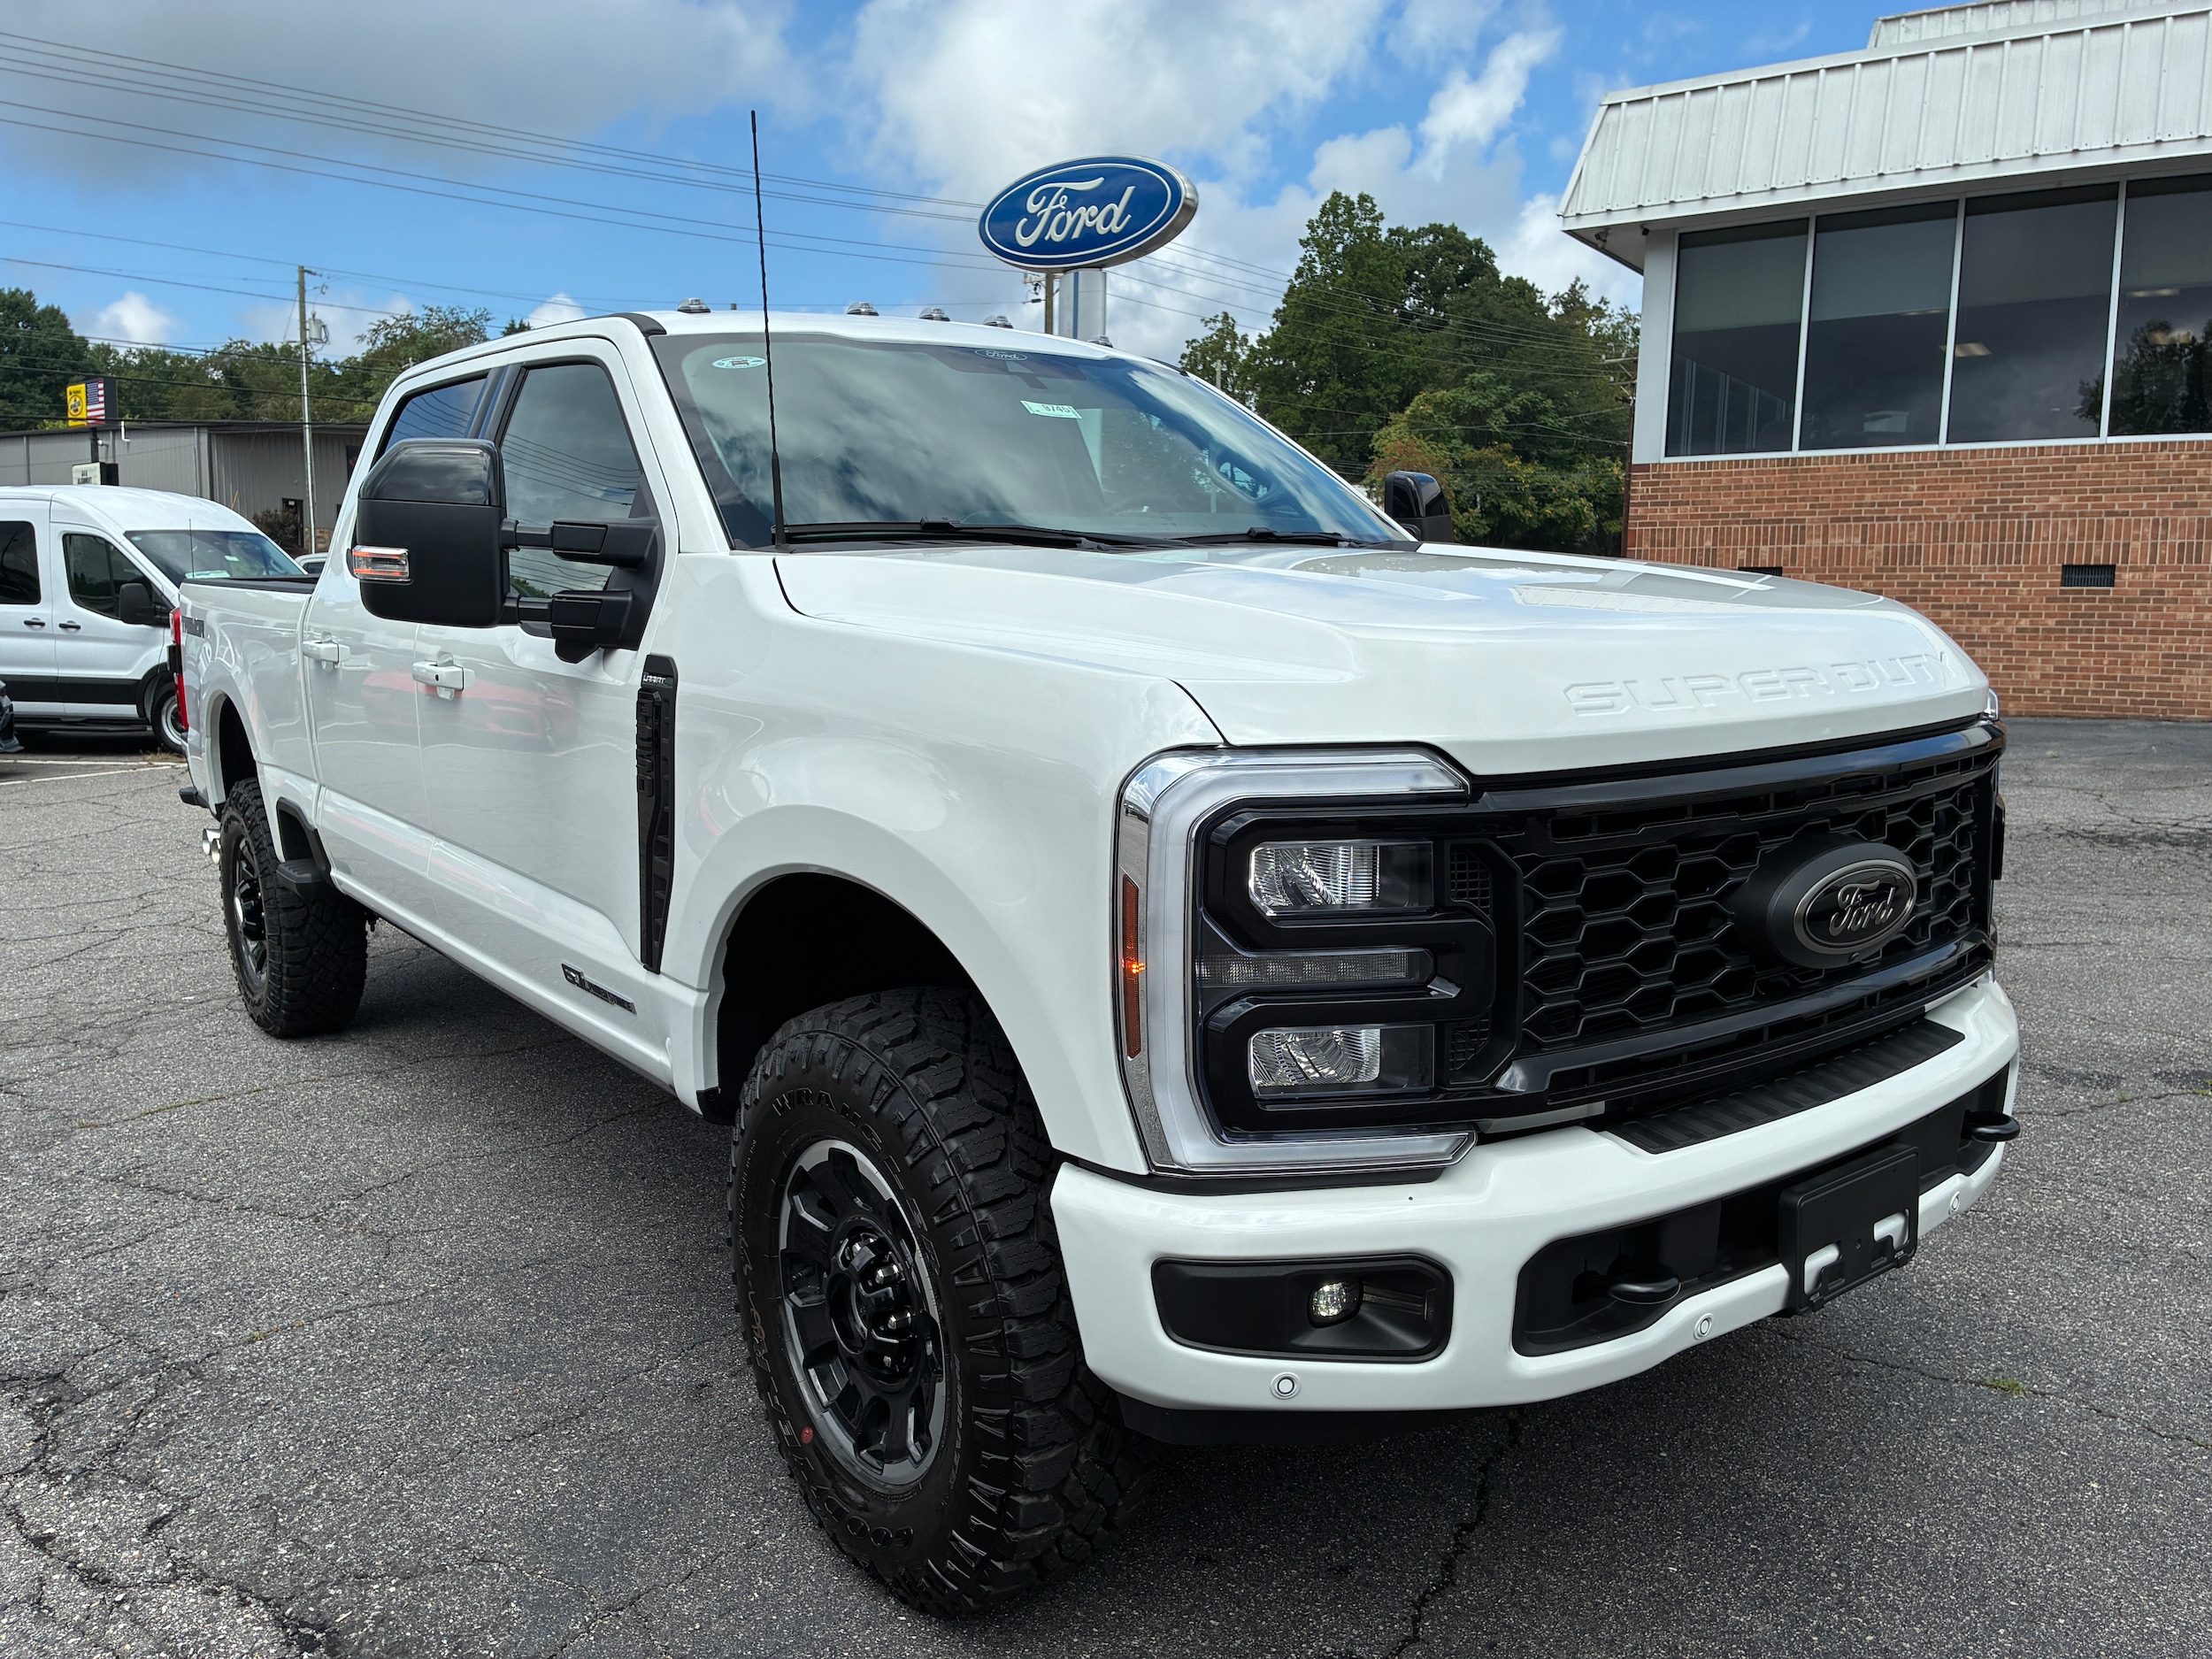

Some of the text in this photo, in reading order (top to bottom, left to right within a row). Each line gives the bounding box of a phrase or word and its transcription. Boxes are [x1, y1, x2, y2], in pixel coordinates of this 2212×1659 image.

[1015, 176, 1136, 248] Ford
[985, 349, 1019, 359] Ford
[1562, 651, 1958, 717] SUPER DUTY
[1829, 879, 1896, 937] Ford
[772, 1087, 941, 1277] WRANGLER
